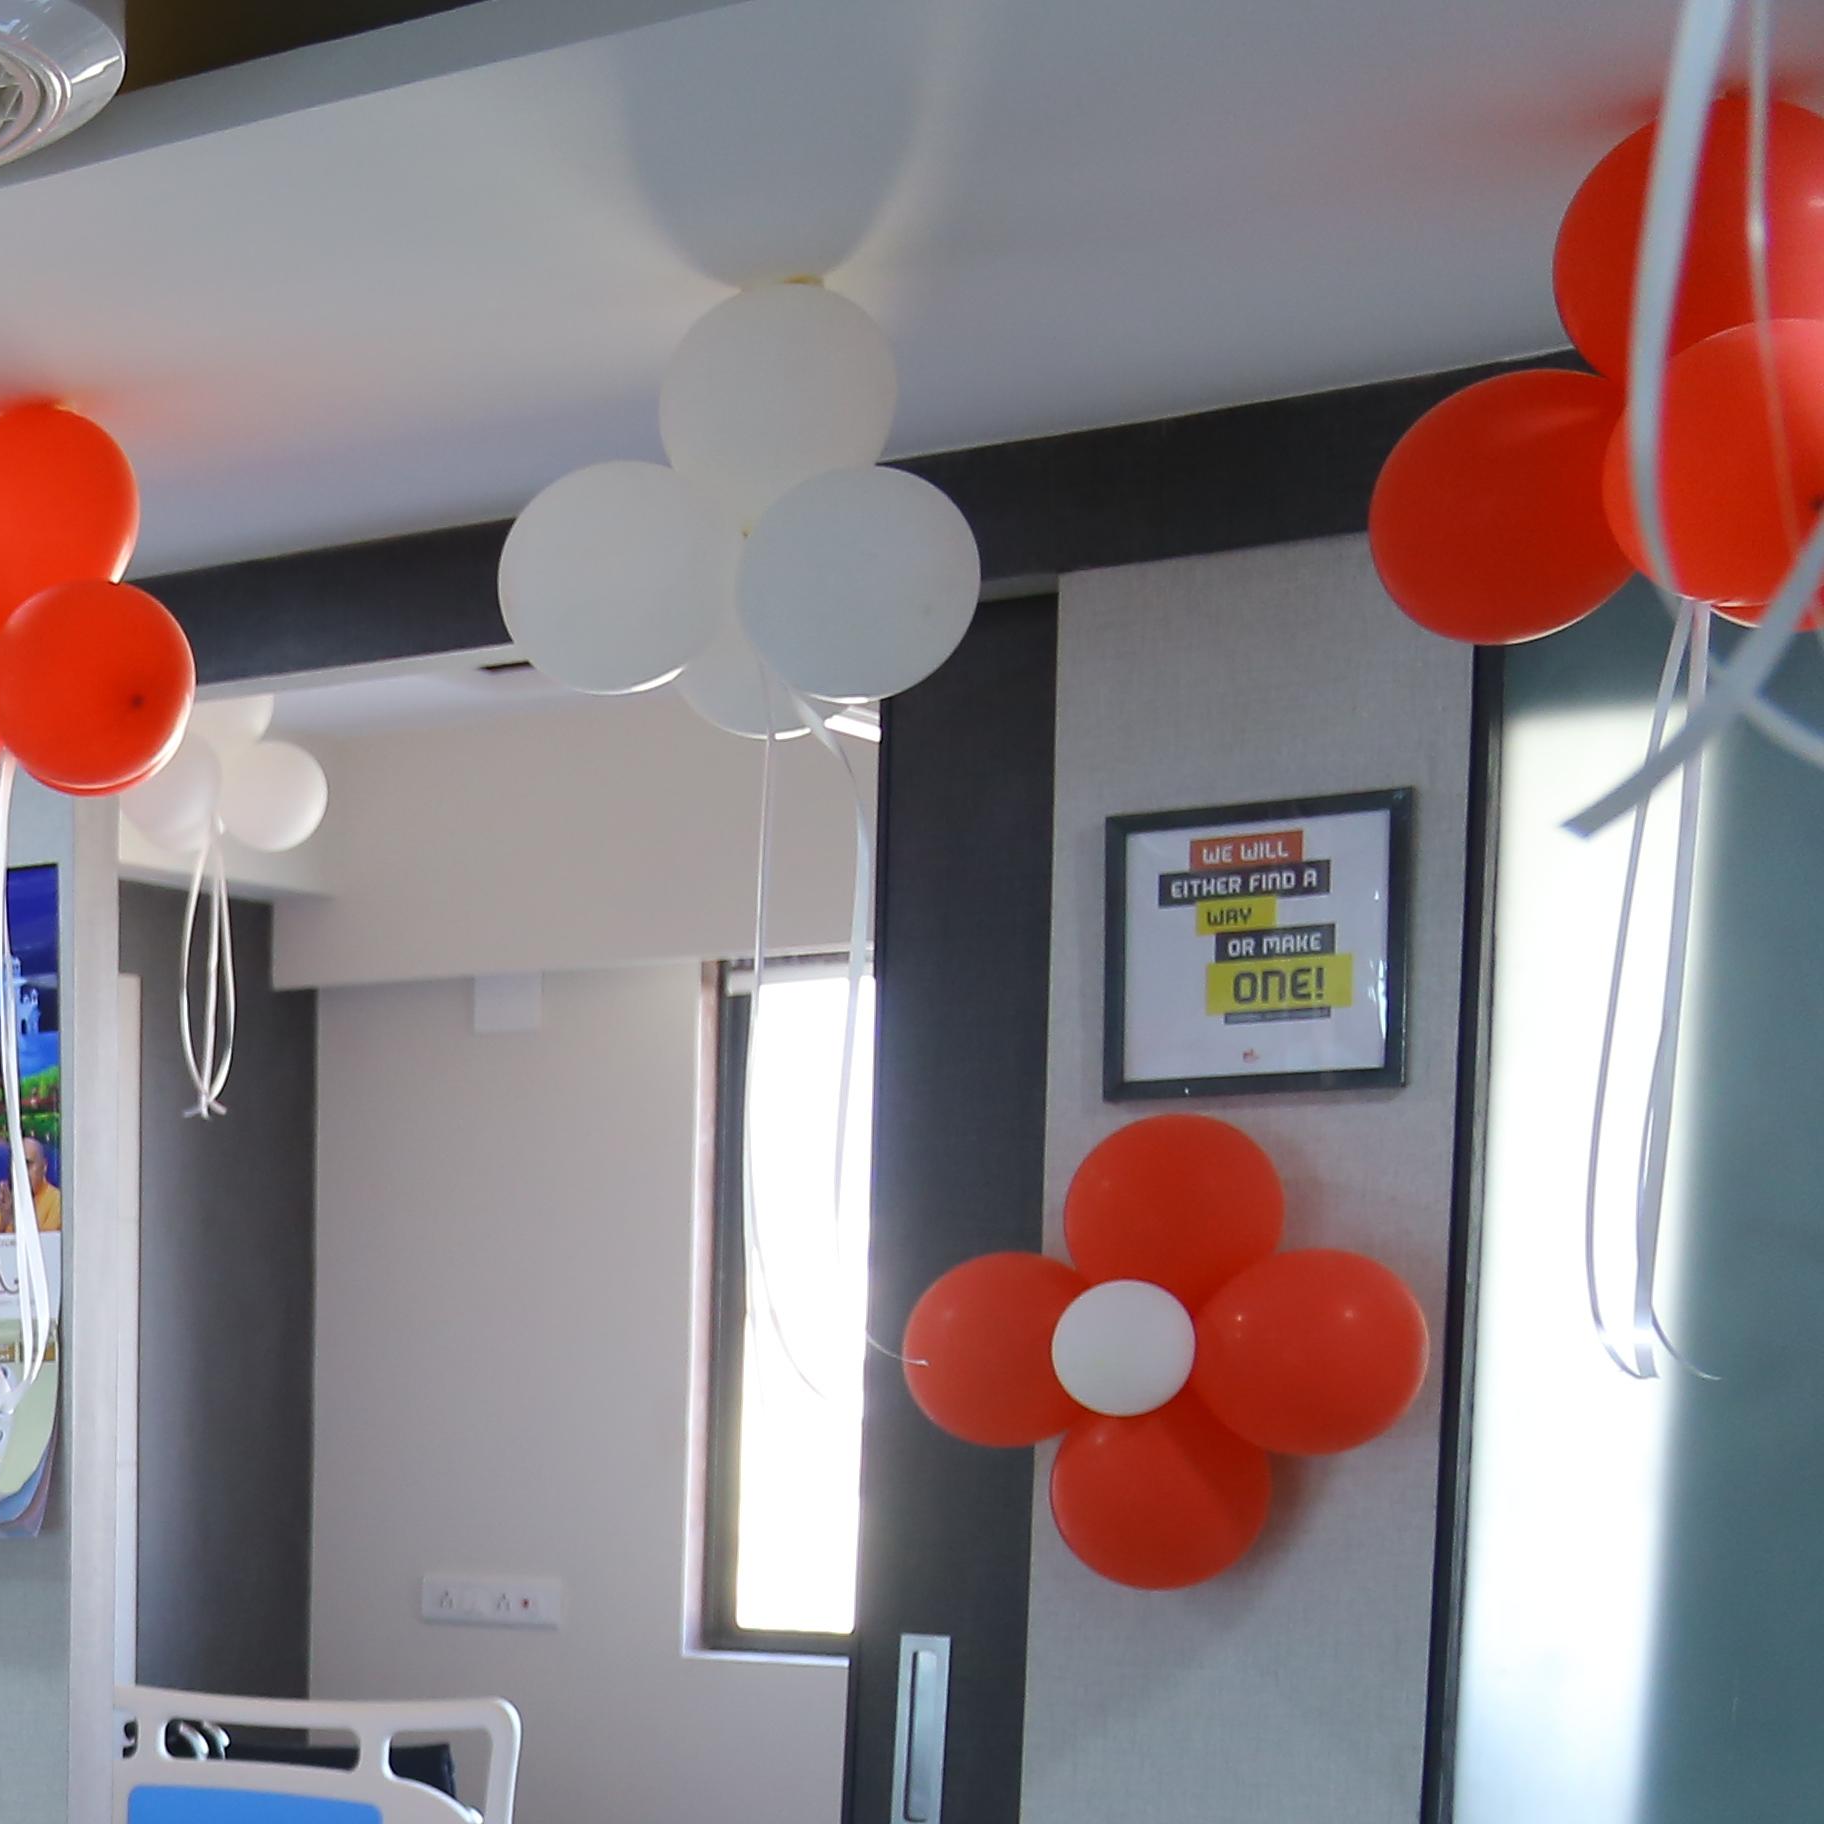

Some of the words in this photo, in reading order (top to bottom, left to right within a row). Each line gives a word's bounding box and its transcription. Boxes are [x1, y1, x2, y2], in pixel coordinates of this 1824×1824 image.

[1203, 845, 1233, 864] WE
[1240, 841, 1289, 862] WILL
[1171, 875, 1242, 899] EITHER
[1249, 871, 1296, 893] FIND
[1303, 868, 1318, 887] A
[1207, 907, 1253, 927] WAY
[1228, 938, 1255, 957] OR
[1263, 932, 1322, 955] MAKE
[1233, 966, 1325, 1004] ONE!
